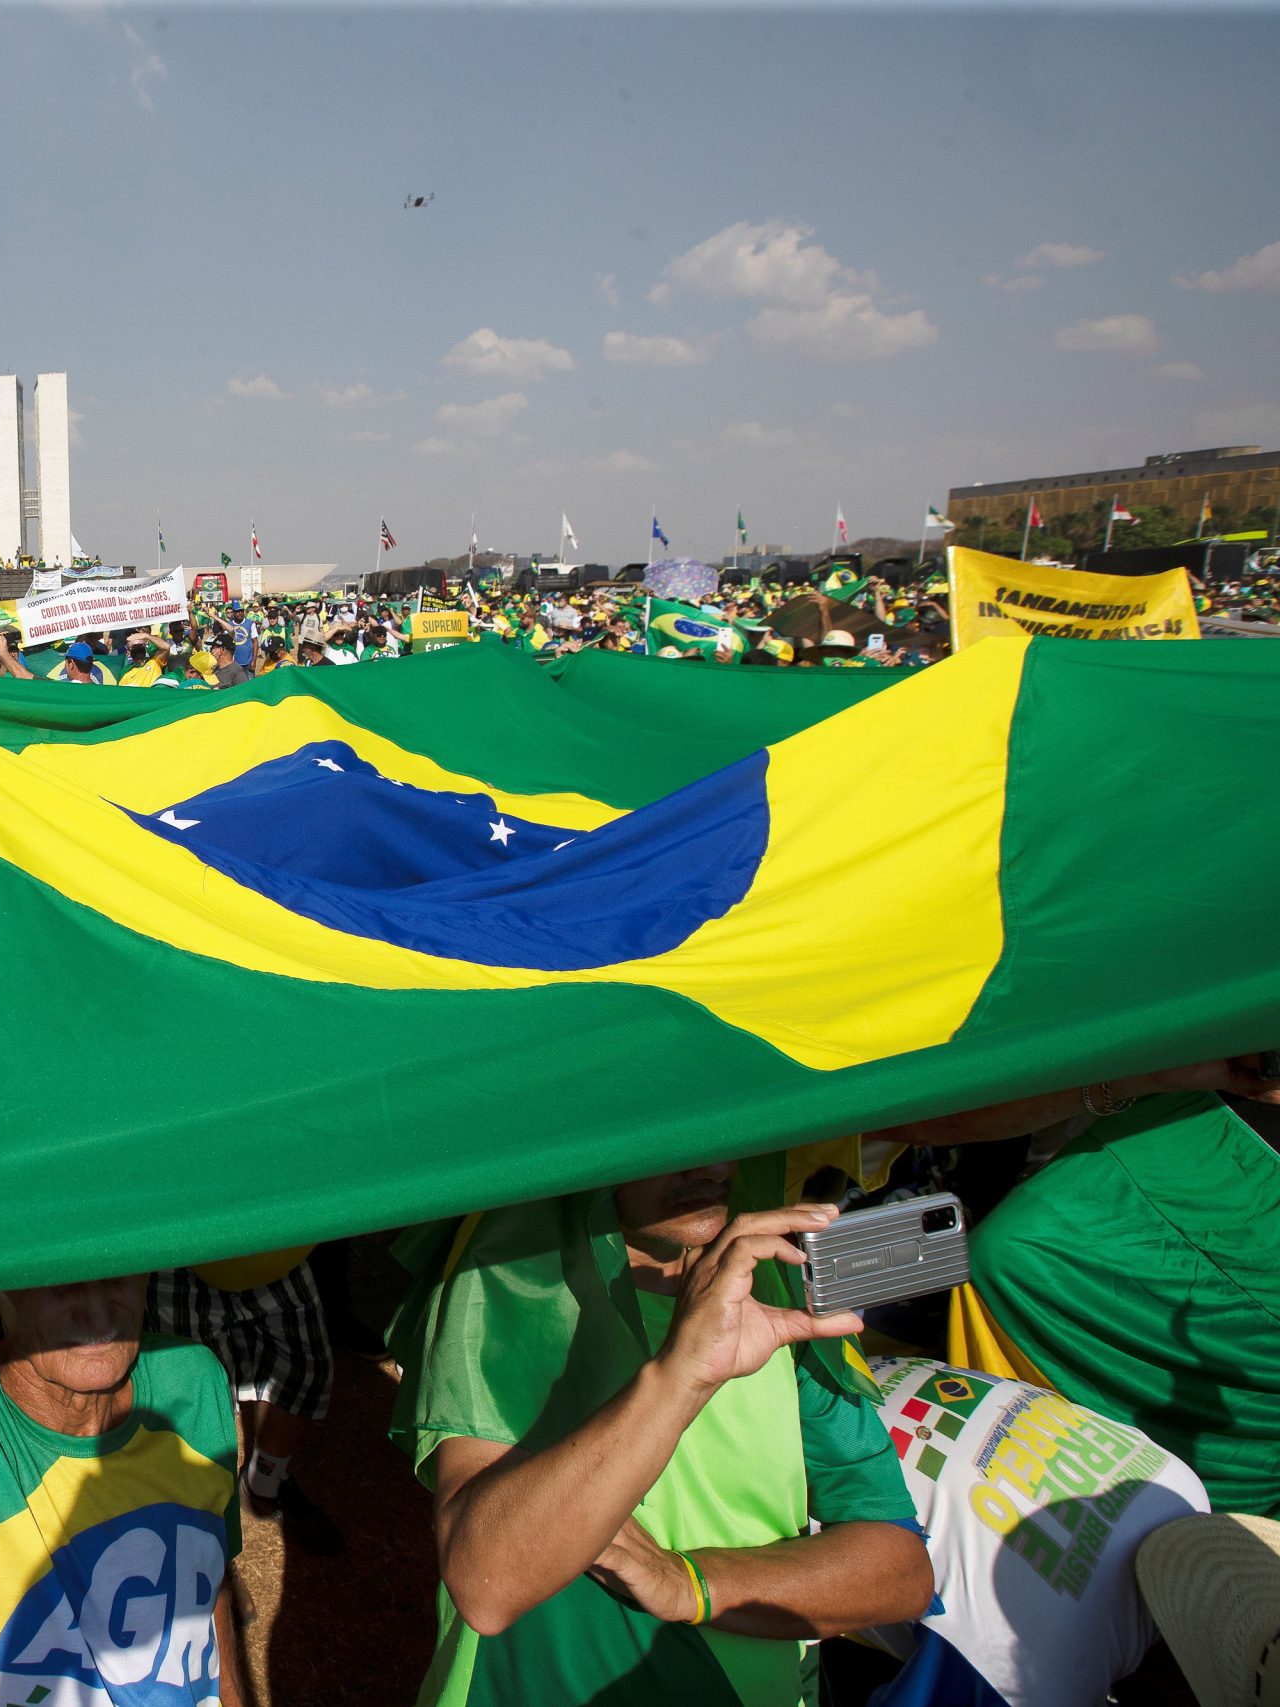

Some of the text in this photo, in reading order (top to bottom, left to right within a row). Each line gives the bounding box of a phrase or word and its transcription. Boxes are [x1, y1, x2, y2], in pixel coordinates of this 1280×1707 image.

[40, 604, 70, 619] CONTRA
[71, 603, 77, 612] O
[77, 597, 116, 611] DESMANDO
[995, 587, 1131, 620] SANEAMENTO
[29, 618, 79, 638] COMBATENDO
[81, 616, 87, 627] A
[87, 611, 128, 625] ILEGALIDADE
[129, 608, 144, 620] COM
[422, 619, 462, 633] SUPREMO
[851, 1257, 879, 1269] SAMSUNG
[1030, 1415, 1143, 1531] VERDE
[1053, 1511, 1109, 1594] BRASIL
